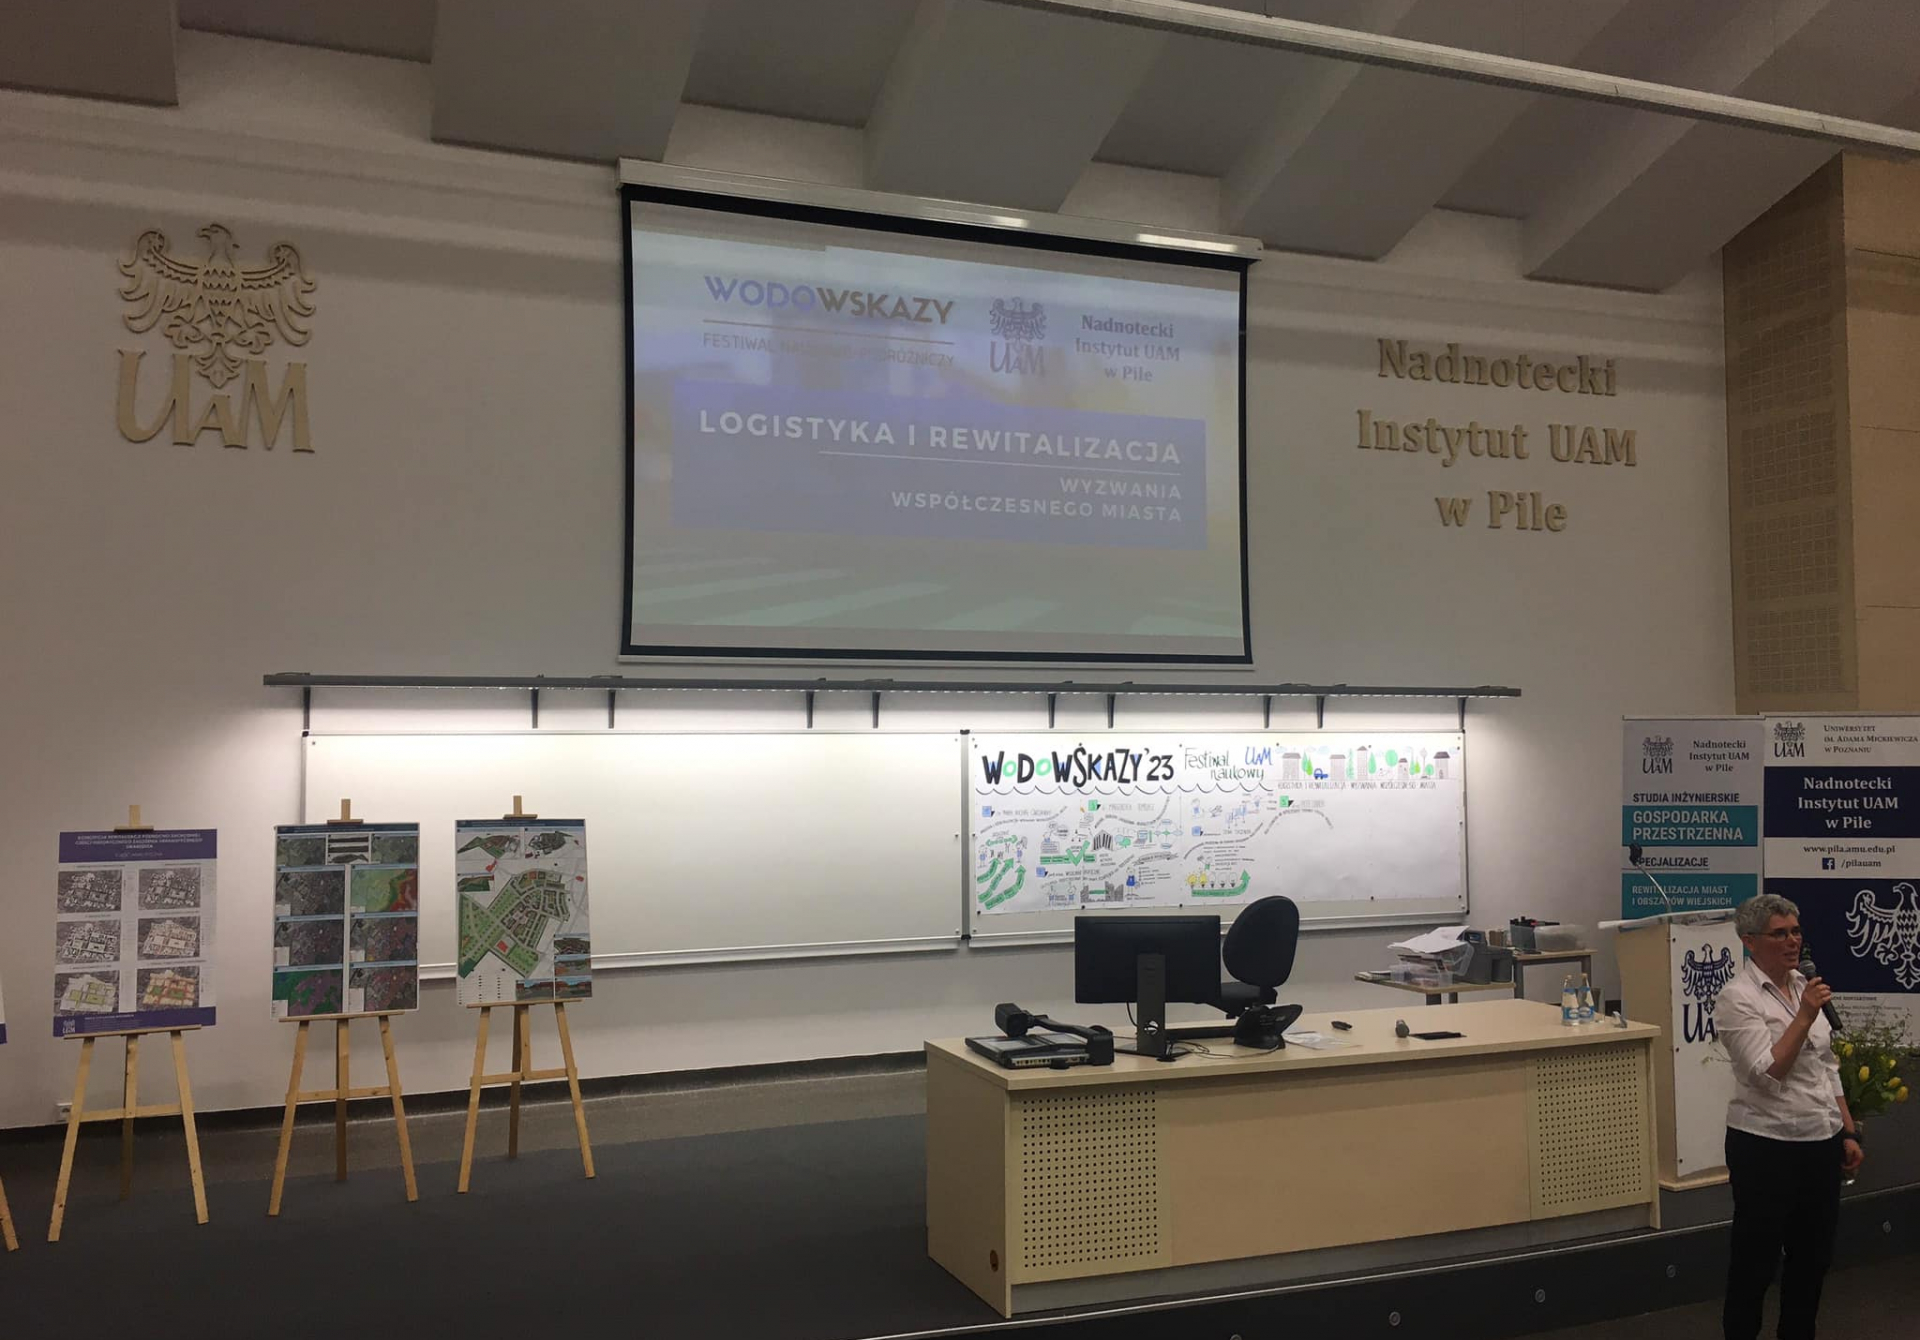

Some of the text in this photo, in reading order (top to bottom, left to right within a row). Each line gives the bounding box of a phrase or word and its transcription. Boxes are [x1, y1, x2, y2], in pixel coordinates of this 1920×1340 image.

[703, 275, 955, 325] WODOWSKAZY
[1081, 314, 1174, 338] Nadnotecki
[702, 332, 777, 354] FESTIWAL
[1075, 337, 1180, 362] Instytut UAM
[989, 341, 1045, 377] UAM
[1377, 338, 1618, 396] Nadnotecki
[1104, 366, 1153, 382] w Pile
[117, 349, 316, 454] UAM
[699, 409, 1181, 465] LOGISTYKA I REWITALIZACJA
[1356, 409, 1637, 468] Instytut UAM
[1059, 477, 1182, 499] WYZWANIA
[891, 491, 1182, 522] WSPÓŁCZESNEGO MIASTA
[1434, 490, 1568, 532] w Pile
[1692, 740, 1746, 749] Nadnotecki
[1774, 742, 1805, 758] UAM
[1184, 746, 1274, 770] Festiwal UAM
[1689, 752, 1750, 762] Instytut UAM
[1210, 765, 1264, 781] naukowy
[1642, 758, 1673, 774] UAM
[1716, 764, 1734, 772] Pile
[1803, 776, 1893, 790] Nadnotecki
[1633, 791, 1740, 803] STUDIA INŻYNIERSKIE
[1798, 797, 1899, 810] Instytut UAM
[1633, 810, 1729, 824] GOSPODARKA
[1825, 816, 1872, 829] w Pile
[1633, 827, 1744, 841] PRZESTRZENNA
[1803, 845, 1896, 854] www.pila.amu.edu.pl
[1634, 857, 1709, 867] PECJALIZACJE
[1840, 859, 1882, 868] /pilauam
[1702, 885, 1729, 894] MIAST
[1686, 897, 1732, 906] WIEJSKICH
[1682, 1003, 1718, 1043] UA
